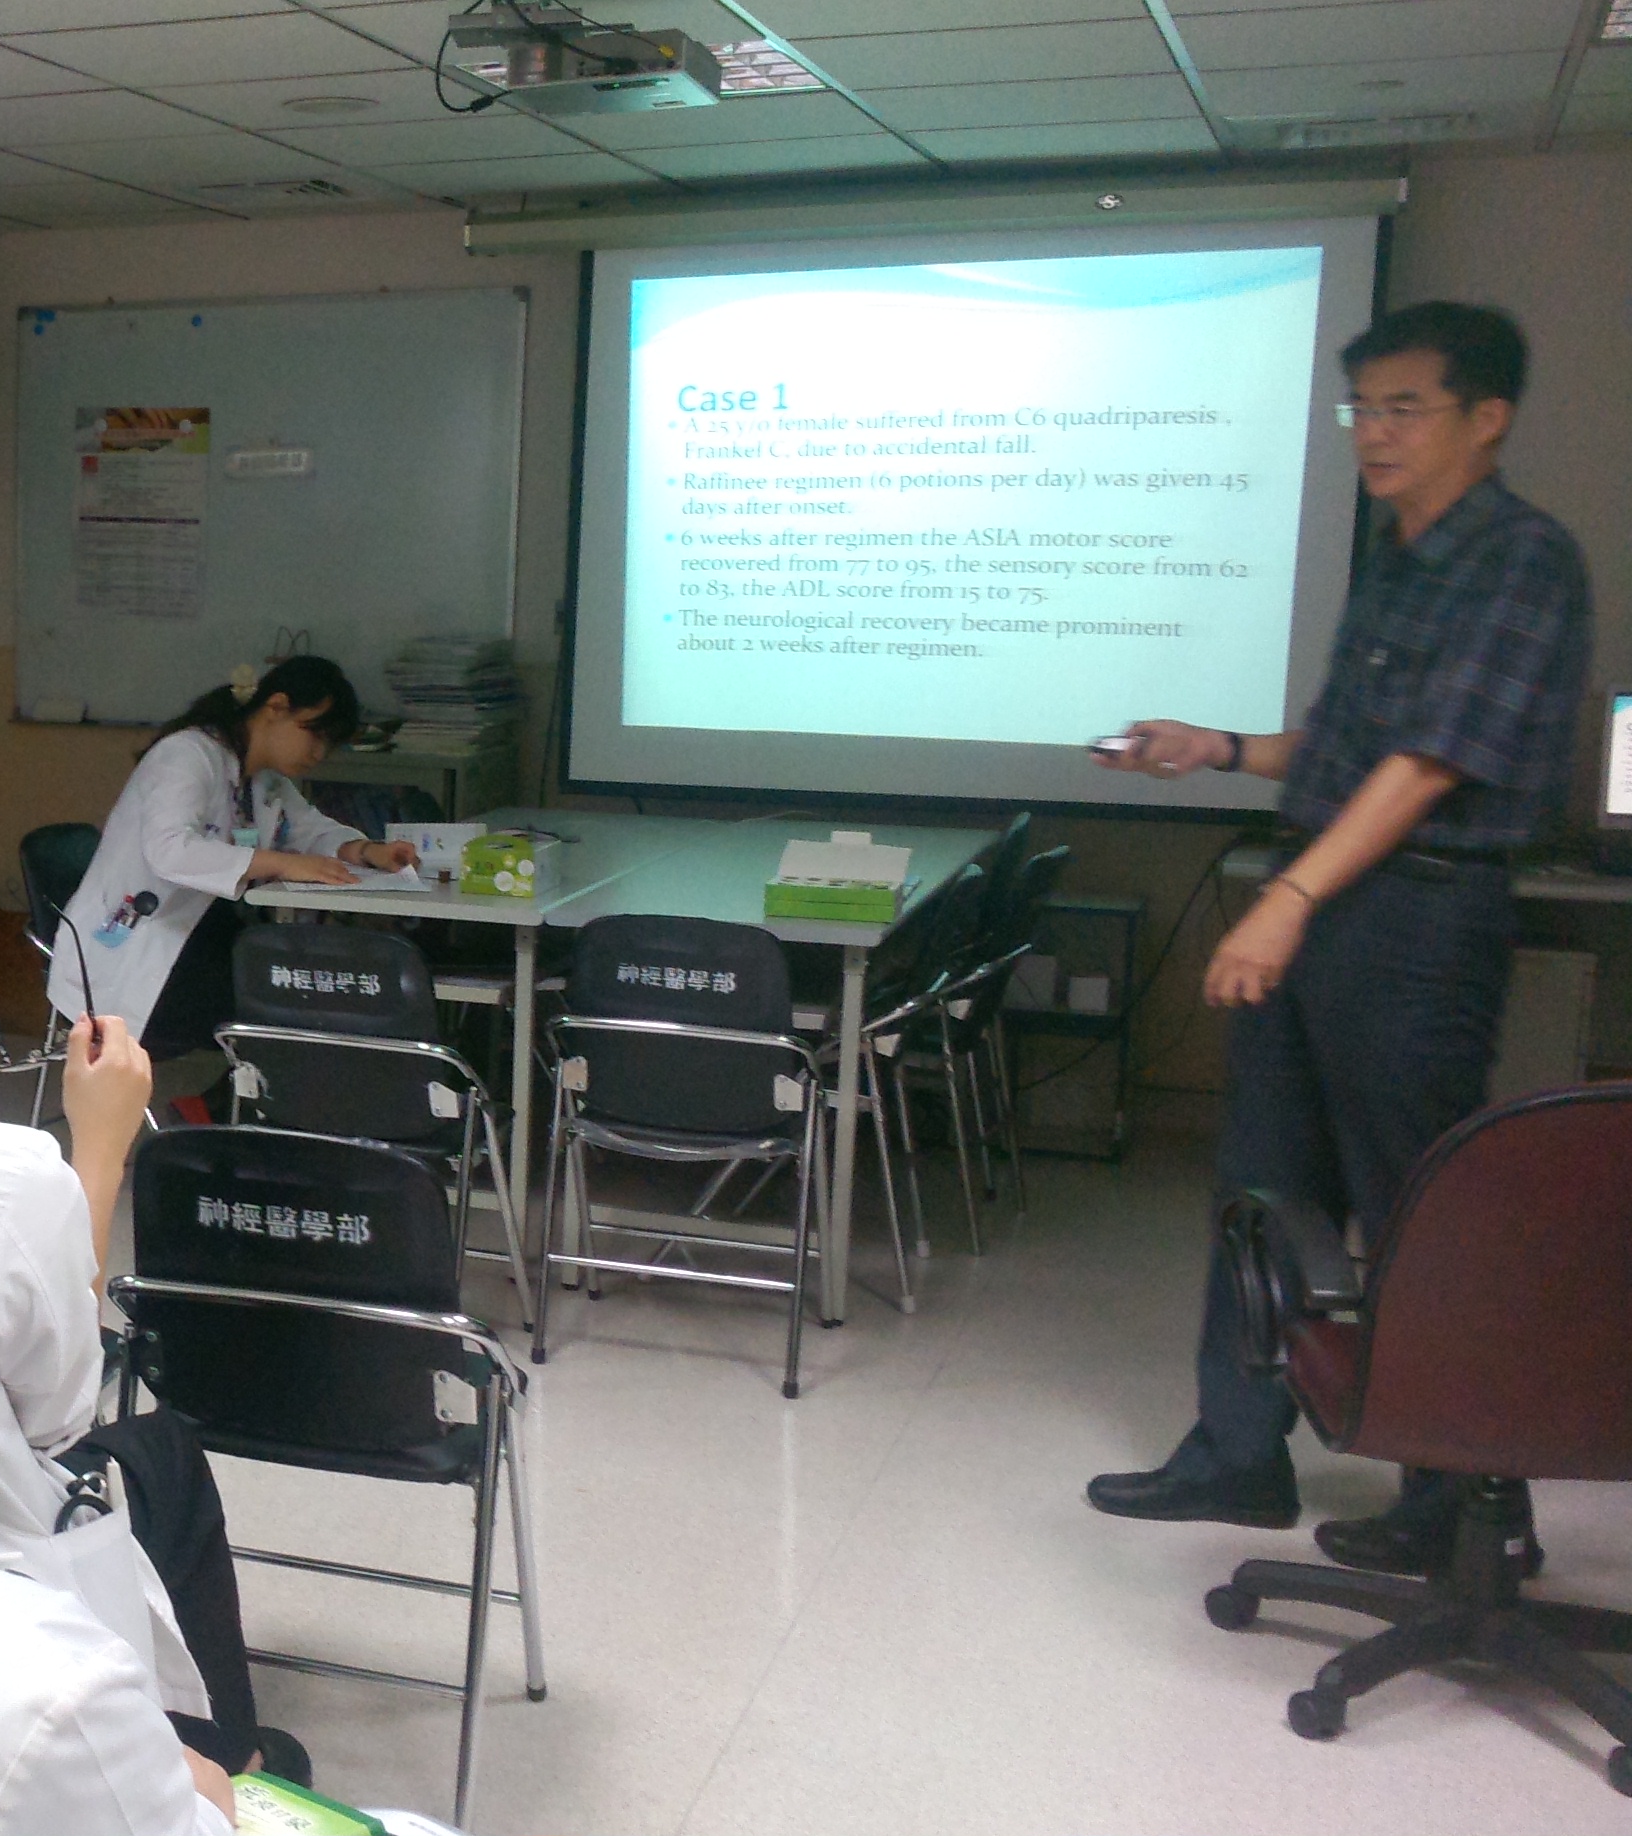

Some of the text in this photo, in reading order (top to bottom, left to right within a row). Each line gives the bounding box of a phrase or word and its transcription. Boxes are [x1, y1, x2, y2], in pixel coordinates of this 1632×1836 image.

[676, 383, 789, 412] Case 1
[776, 414, 849, 431] female
[855, 409, 944, 429] suffered
[952, 407, 1006, 427] from
[1014, 407, 1046, 427] C6
[1053, 404, 1218, 431] quadriparesis
[684, 441, 762, 459] Frankel
[797, 439, 837, 458] due
[844, 440, 866, 457] to
[873, 435, 987, 456] accidental
[995, 434, 1037, 454] fall.
[775, 473, 862, 495] regimen
[899, 469, 983, 493] potions
[991, 474, 1028, 493] per
[1035, 467, 1087, 493] day)
[1093, 473, 1139, 488] was
[1145, 468, 1212, 493] given
[1218, 472, 1248, 493] 45
[682, 496, 852, 519] days after onset.
[680, 527, 1173, 551] 6 weeks after regimen the ASIA motor score
[680, 554, 781, 572] recovered
[789, 554, 839, 573] from
[846, 559, 871, 576] 77
[876, 558, 899, 573] to
[944, 554, 982, 574] the
[988, 558, 1077, 580] sensory
[1082, 562, 1146, 576] score
[1153, 555, 1212, 577] from
[1219, 558, 1248, 578] 62
[679, 580, 700, 597] to
[742, 579, 776, 597] the
[781, 579, 831, 598] ADL
[837, 583, 893, 599] score
[900, 580, 952, 600] from
[987, 584, 1010, 600] to
[678, 608, 1183, 639] The neurological recovery became prominent
[677, 633, 984, 661] about 2 weeks after regimen.
[270, 964, 381, 996] 神經醫學部
[616, 962, 736, 994] 神經醫學部
[197, 1195, 371, 1245] 神經醫學部
